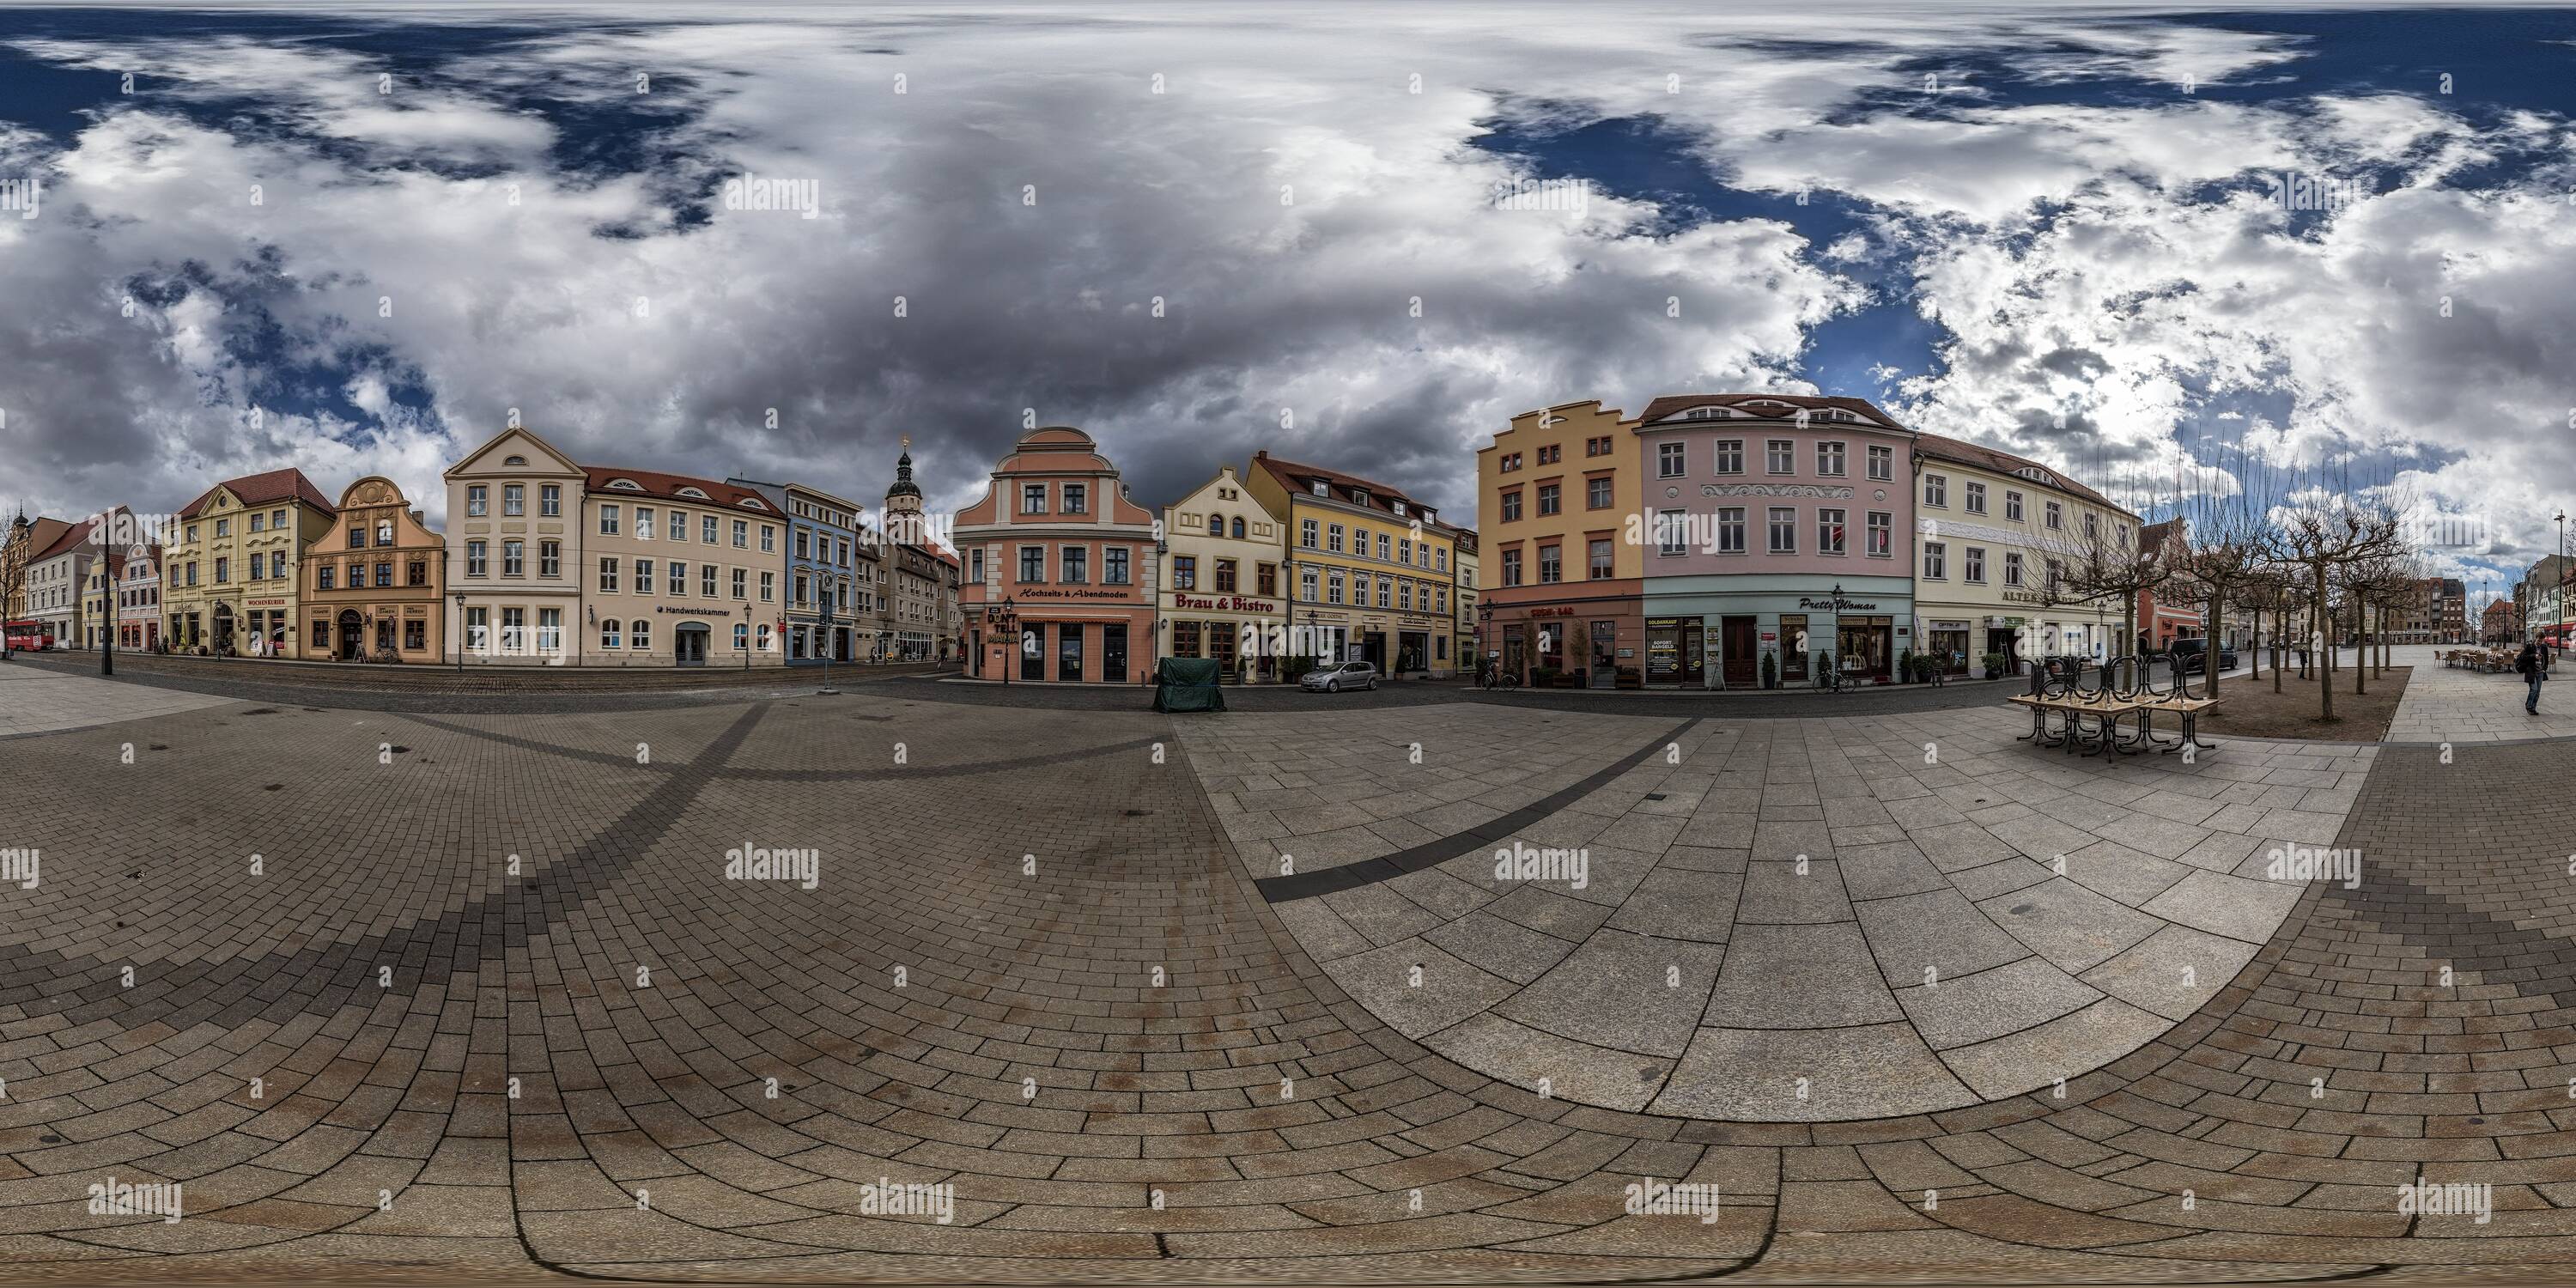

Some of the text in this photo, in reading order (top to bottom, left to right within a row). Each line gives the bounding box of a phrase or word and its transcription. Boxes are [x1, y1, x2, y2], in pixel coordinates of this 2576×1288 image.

[1072, 589, 1128, 598] Abendmoden
[1175, 593, 1274, 612] Brau & Bistro
[1799, 597, 1877, 611] Pretty Woman
[665, 605, 731, 617] Handwerkskammer
[993, 624, 1018, 633] TELL
[987, 633, 1019, 643] MAMA
